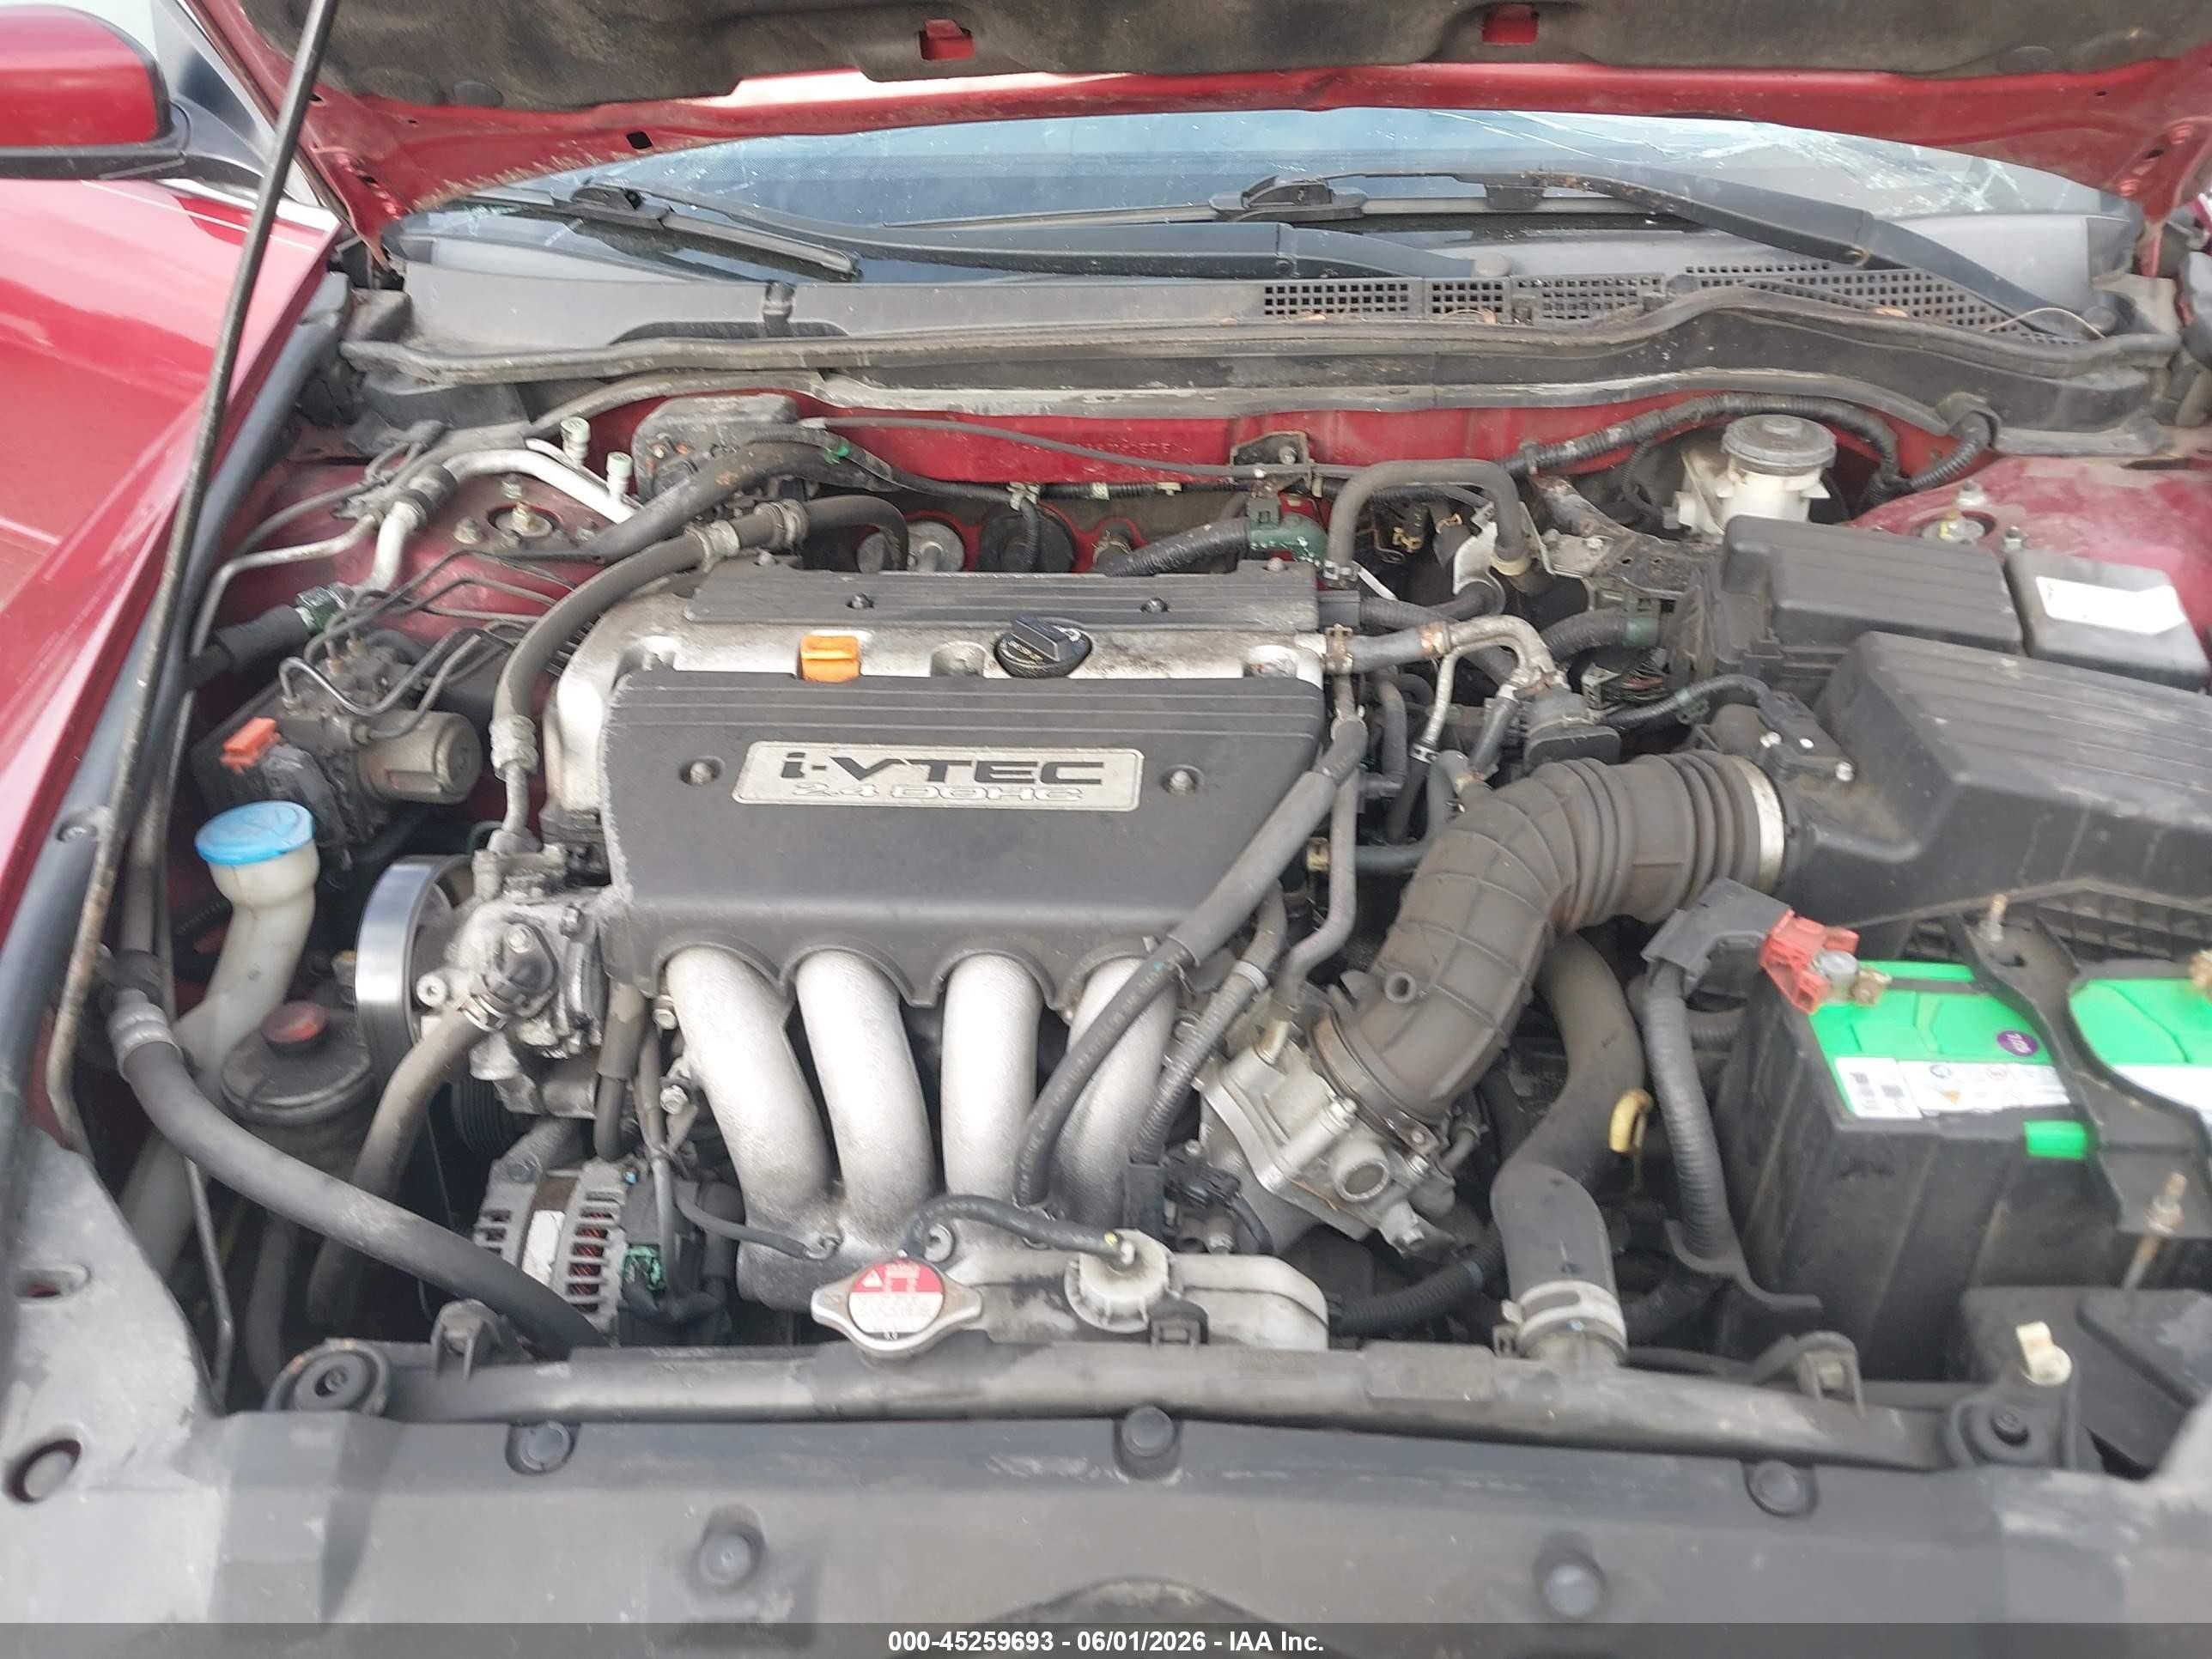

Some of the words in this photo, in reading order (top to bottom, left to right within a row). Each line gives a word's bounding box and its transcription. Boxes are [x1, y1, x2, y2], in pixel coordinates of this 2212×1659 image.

[781, 751, 1104, 785] i-VTEC
[792, 782, 880, 798] 2.4
[890, 784, 1085, 802] DOHC
